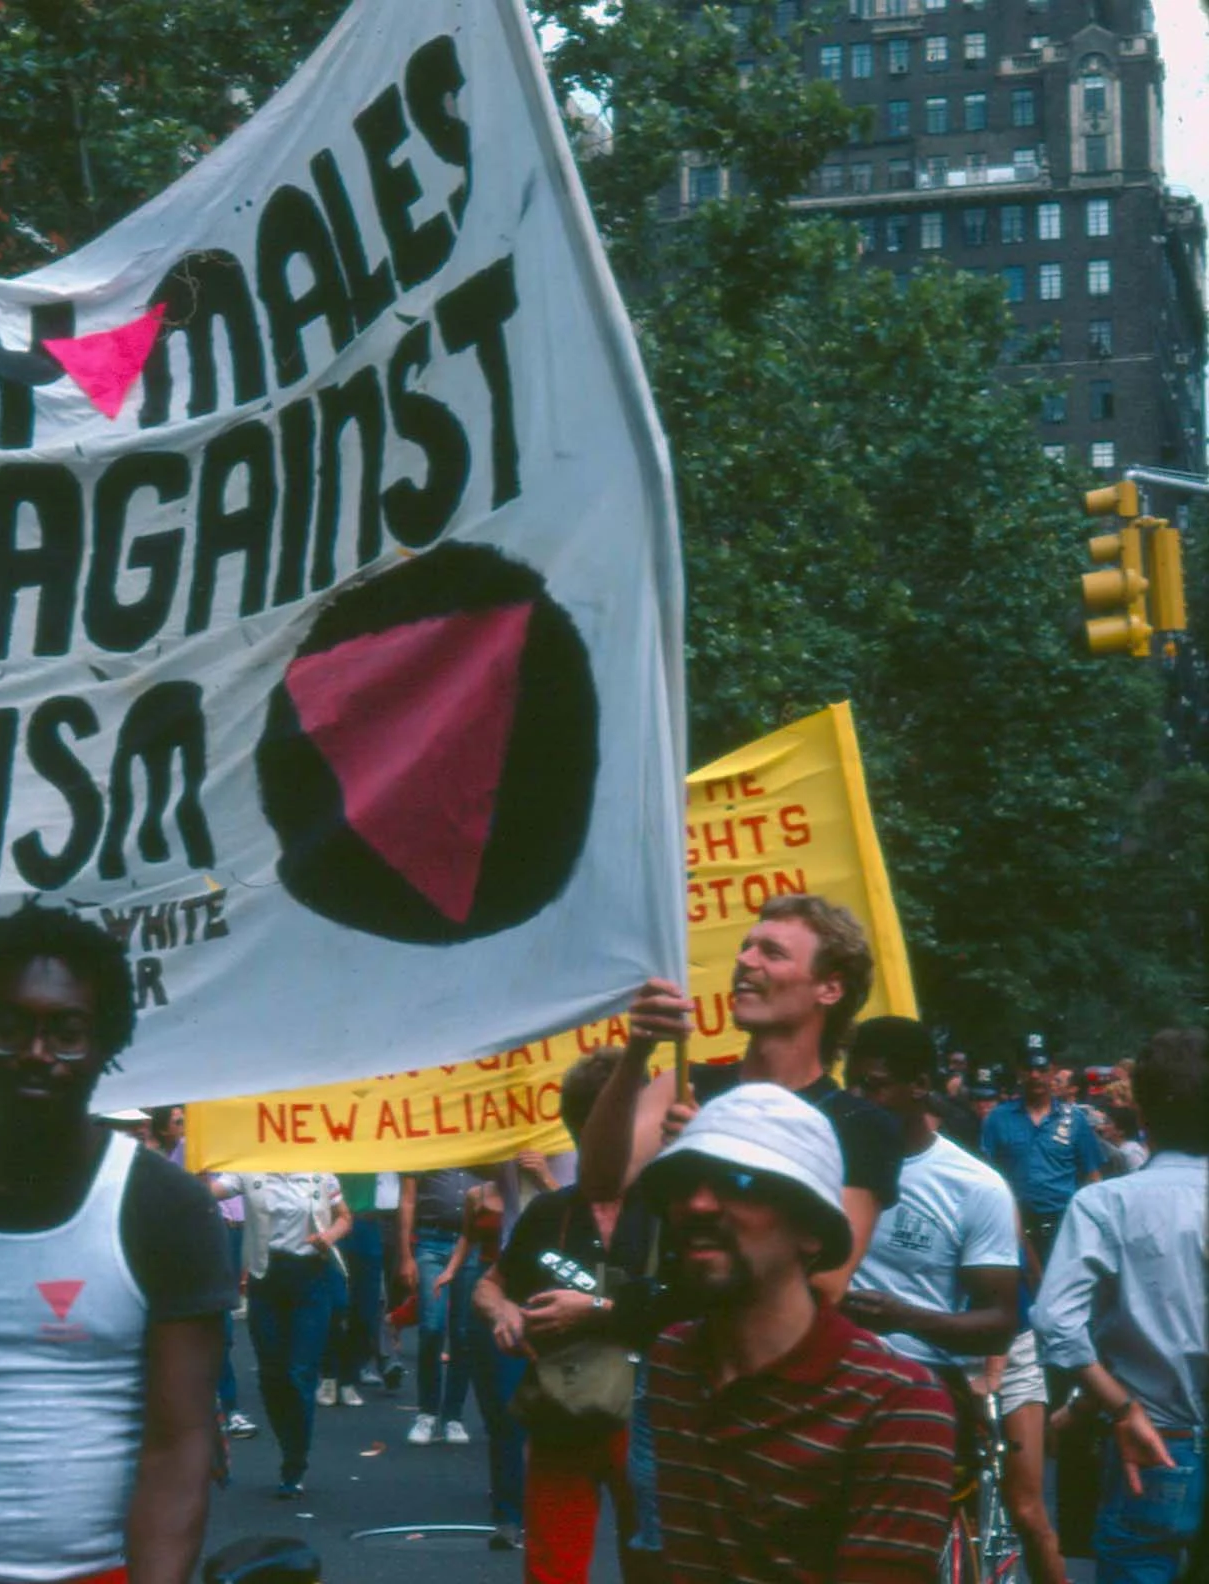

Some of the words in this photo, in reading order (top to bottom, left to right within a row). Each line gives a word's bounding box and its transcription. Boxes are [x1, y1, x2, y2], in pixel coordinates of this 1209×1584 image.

[139, 34, 473, 429] MALES
[99, 888, 230, 952] WHITE
[257, 1101, 358, 1144] NEW
[376, 1081, 561, 1141] ALLIANC
